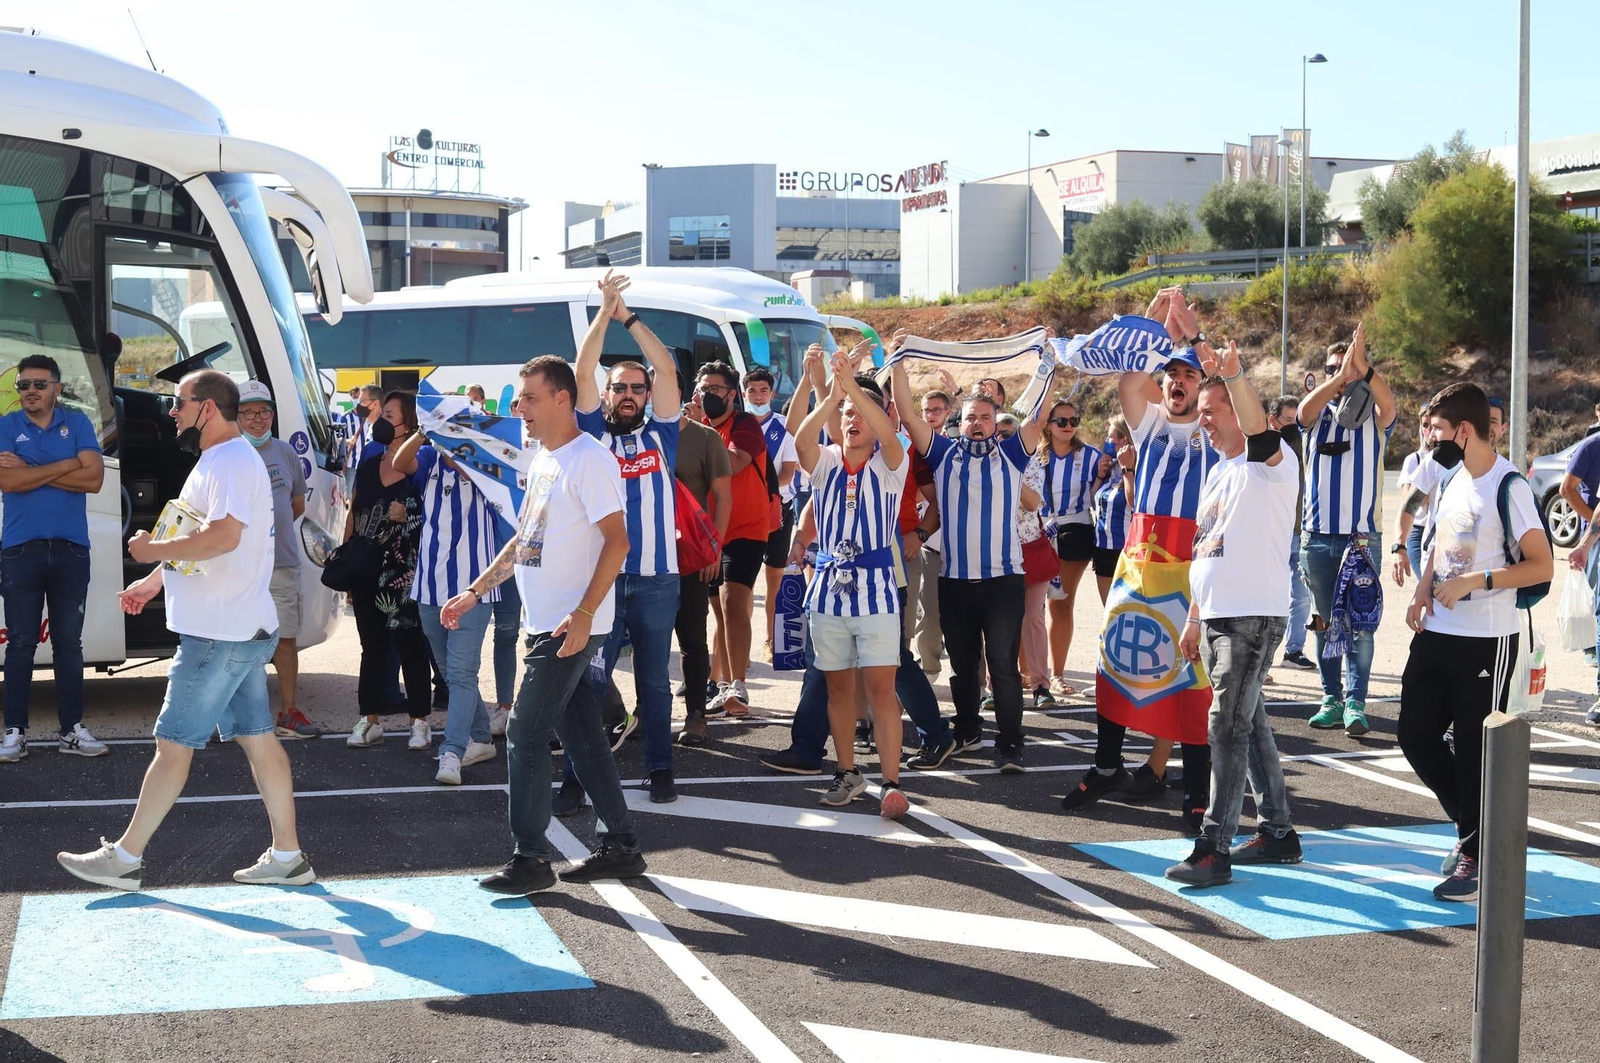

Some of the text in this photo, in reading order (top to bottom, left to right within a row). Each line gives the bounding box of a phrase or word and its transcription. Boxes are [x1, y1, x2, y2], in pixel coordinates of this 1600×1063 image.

[394, 135, 479, 154] LAS CULTURAS
[435, 155, 486, 169] COMERCIAL
[1070, 173, 1105, 196] ALQUILA
[621, 455, 656, 473] CEPSA
[782, 578, 804, 670] ATIVO
